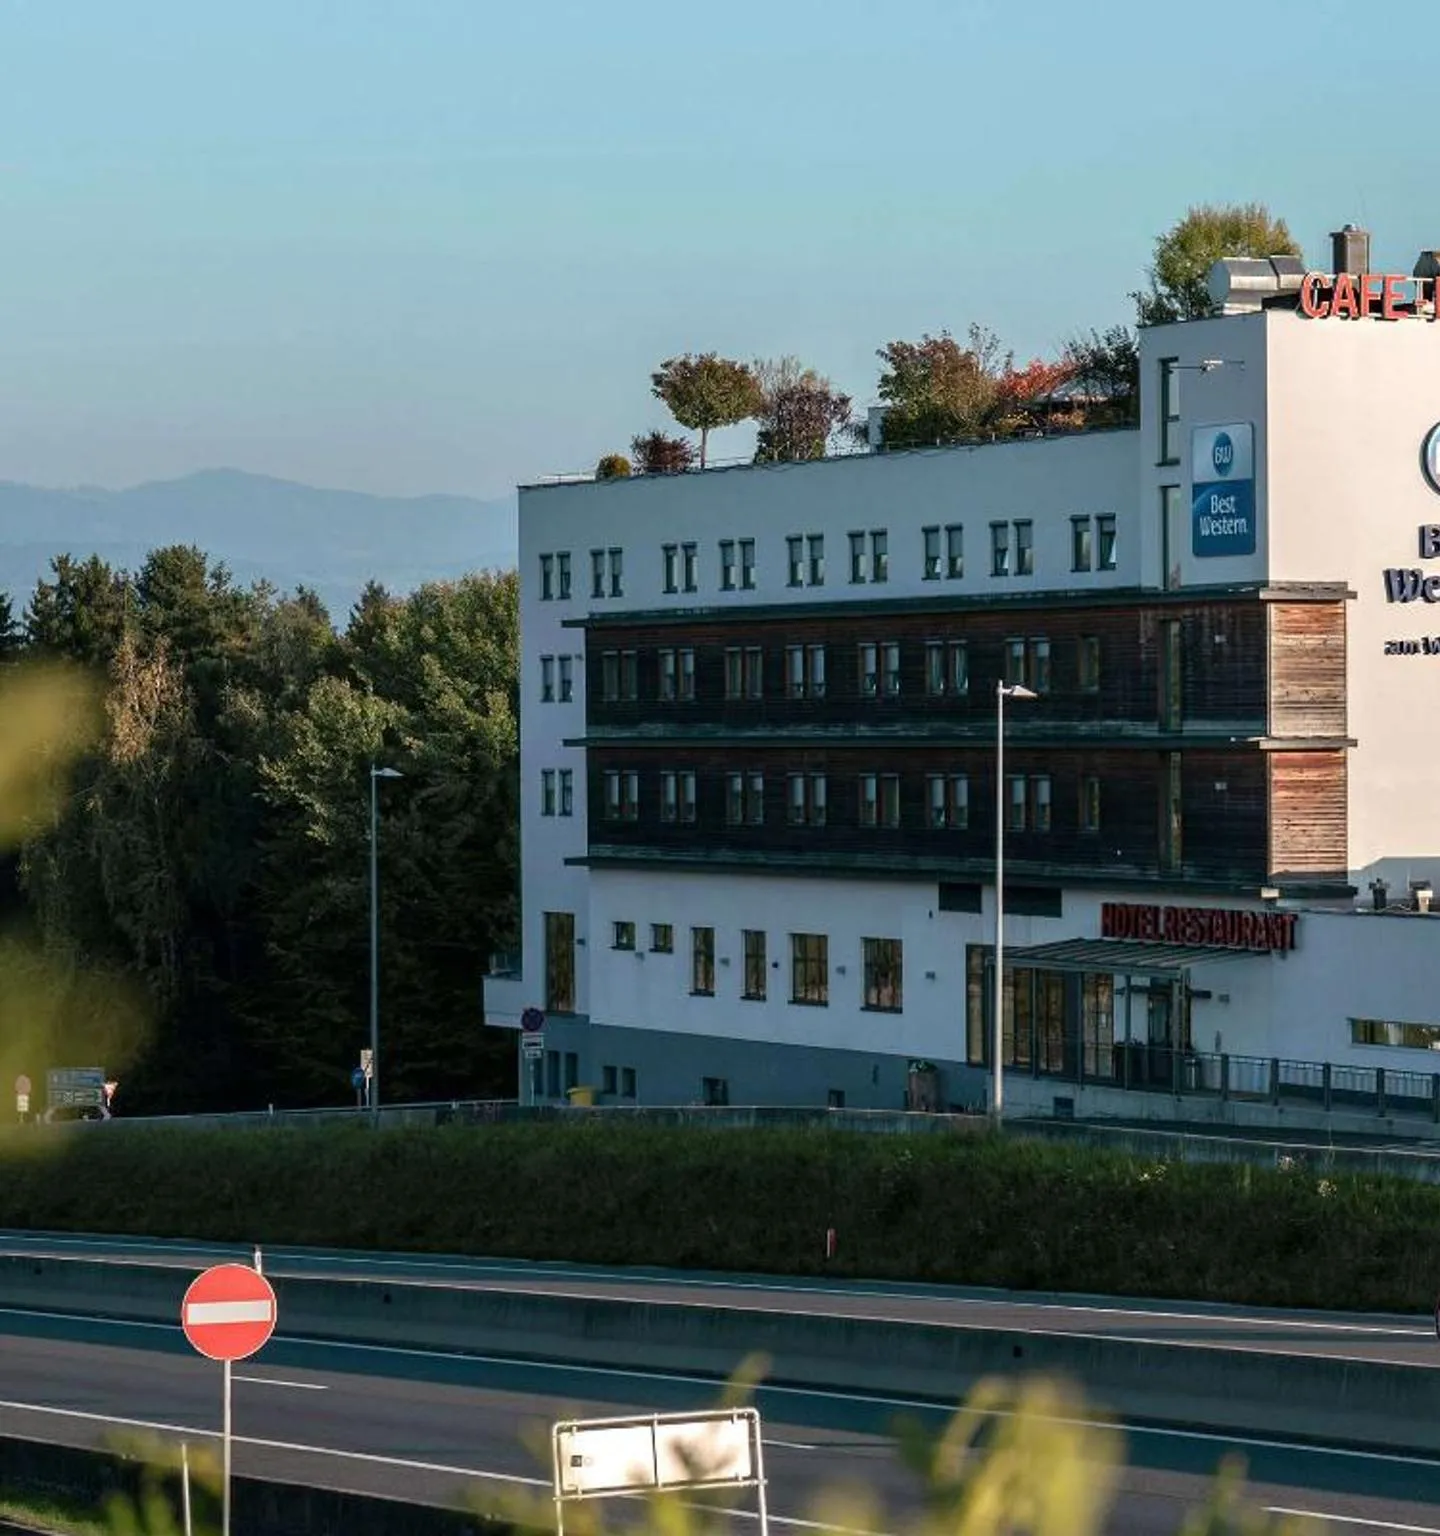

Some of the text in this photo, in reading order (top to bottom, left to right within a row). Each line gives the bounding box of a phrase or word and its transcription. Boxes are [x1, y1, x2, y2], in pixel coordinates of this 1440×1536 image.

[1214, 446, 1232, 464] BW
[1210, 494, 1236, 514] Best
[1200, 516, 1248, 537] Western
[1102, 902, 1298, 951] HOTEL RESTAURANT
